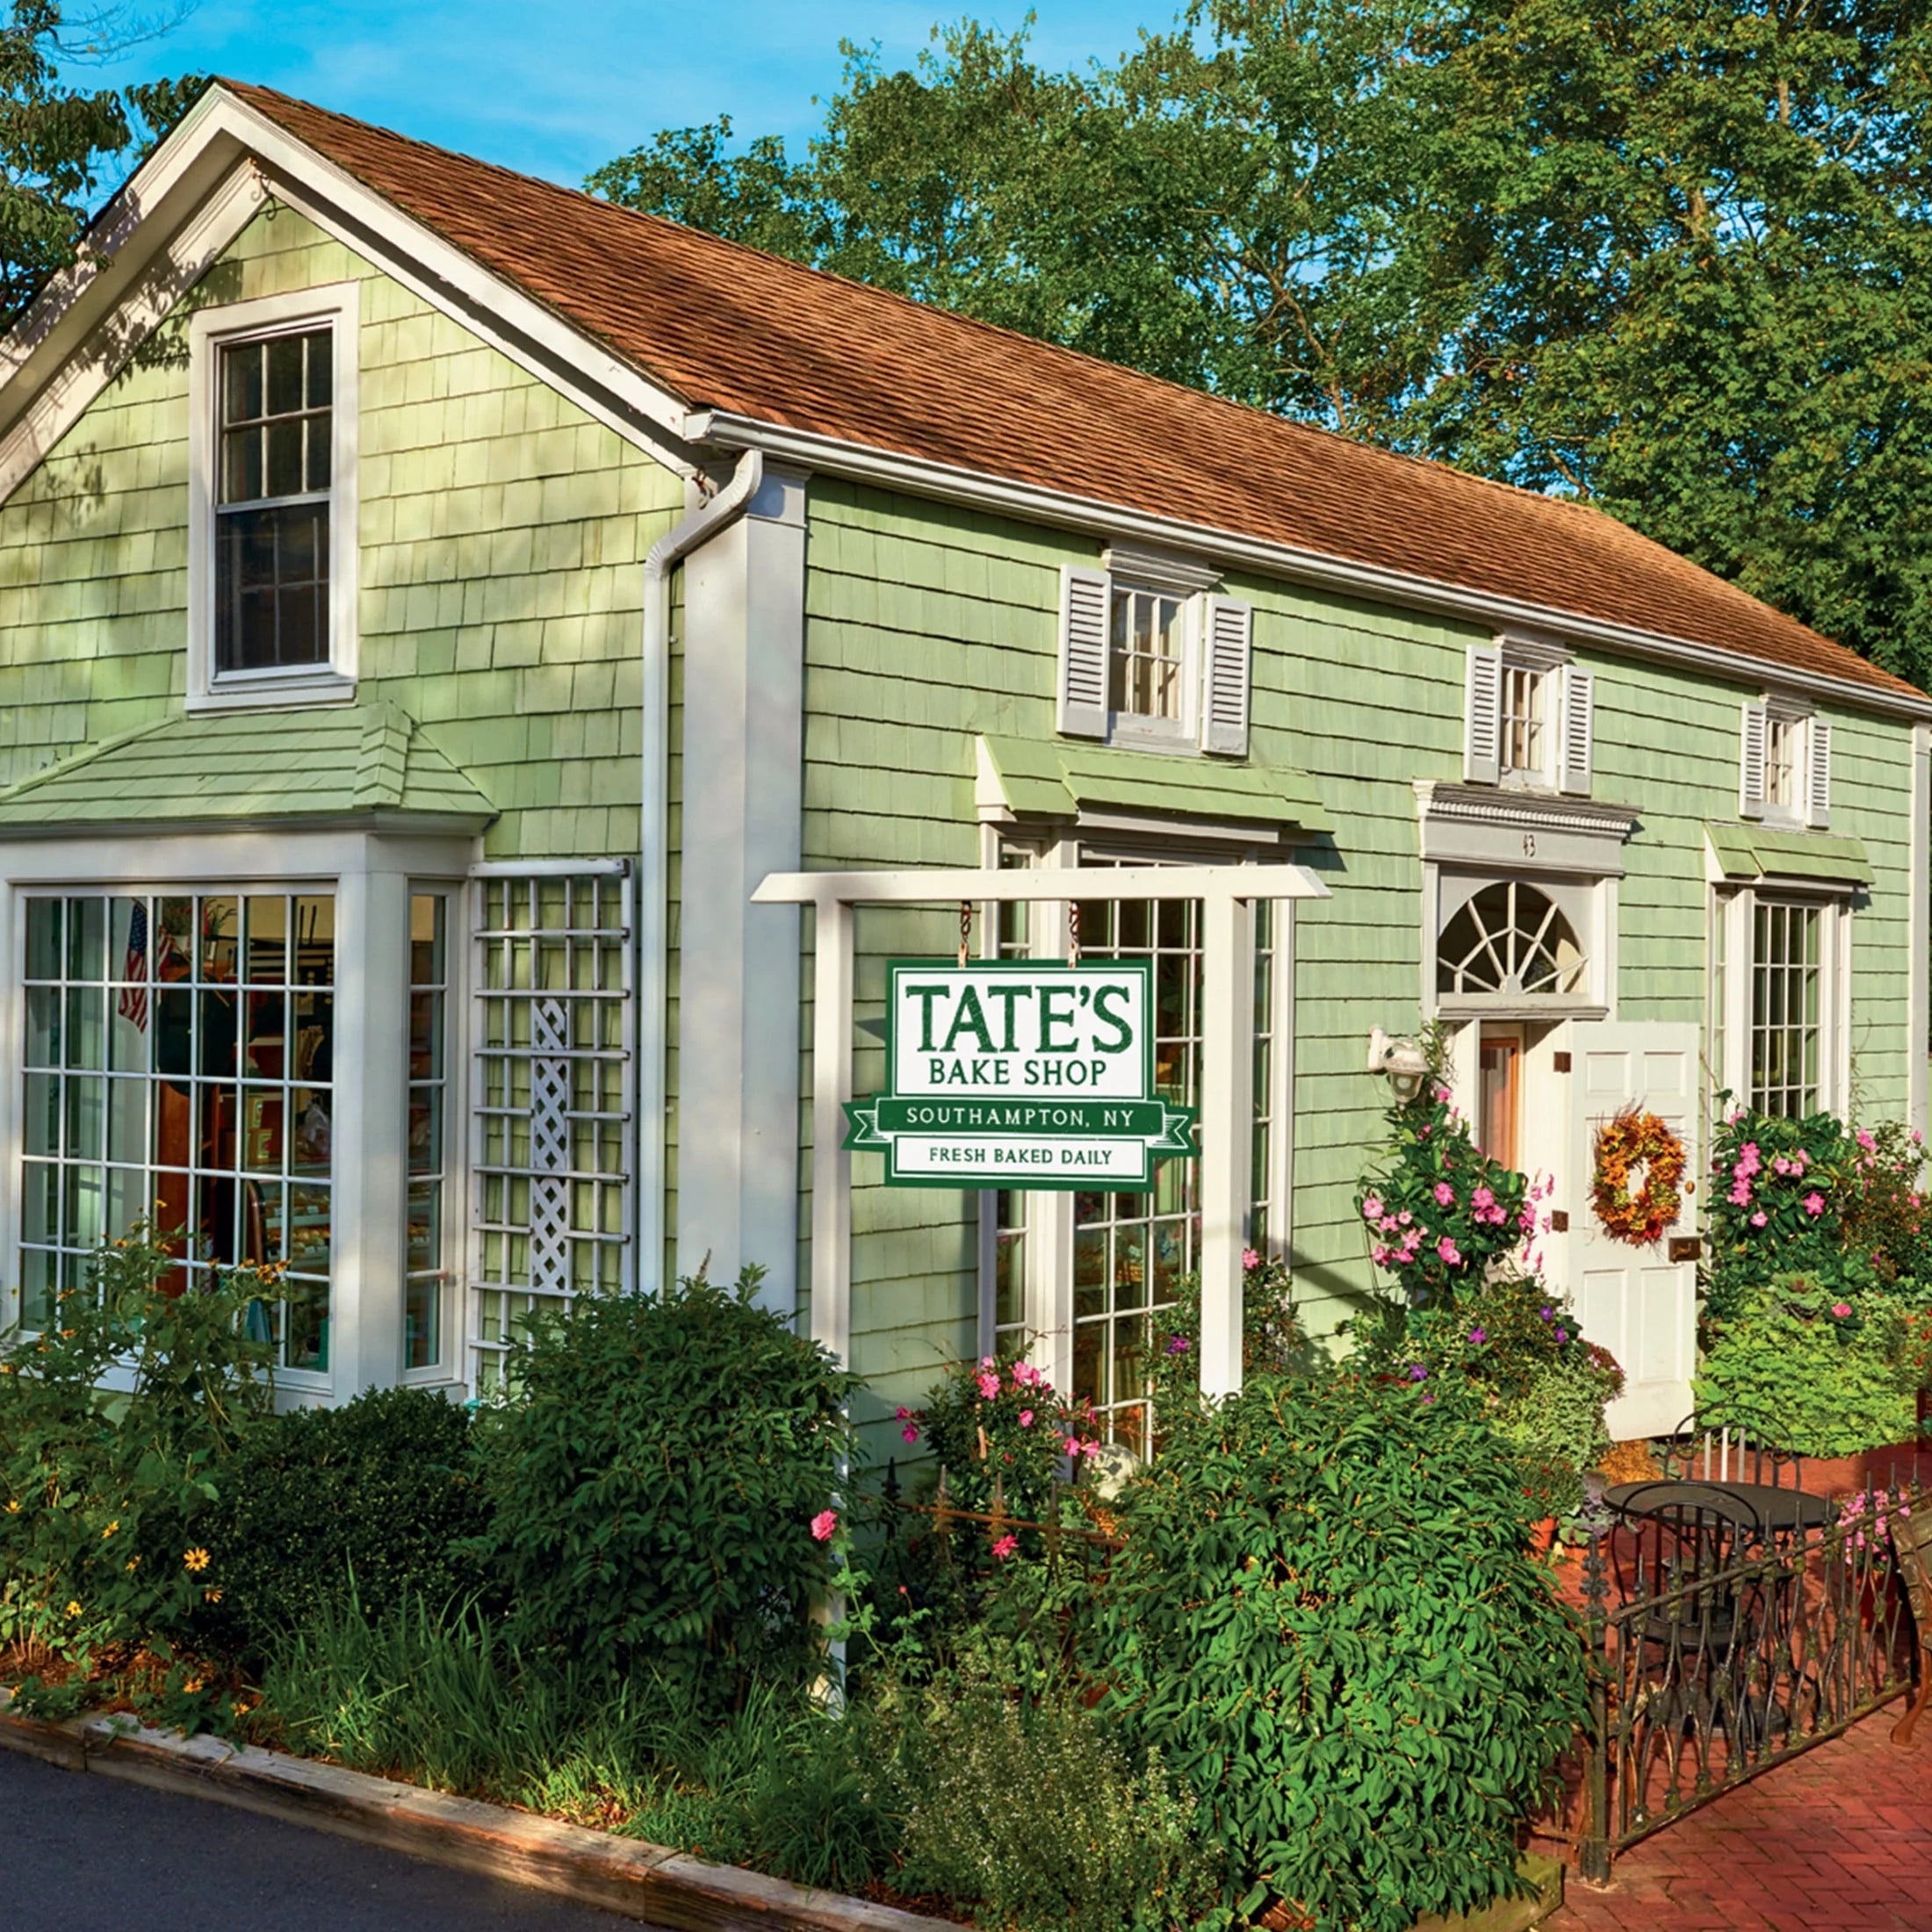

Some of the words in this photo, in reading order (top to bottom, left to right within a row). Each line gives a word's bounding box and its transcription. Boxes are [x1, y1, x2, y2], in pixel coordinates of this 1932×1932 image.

[905, 984, 1133, 1054] TATE'S
[928, 1058, 1011, 1085] BAKE
[1024, 1059, 1107, 1086] SHOP
[906, 1107, 1091, 1128] SOUTHAMPTON,
[1104, 1109, 1135, 1128] NY
[929, 1147, 986, 1164] FRESH
[994, 1147, 1054, 1164] BAKED
[1061, 1149, 1113, 1165] DAILY
